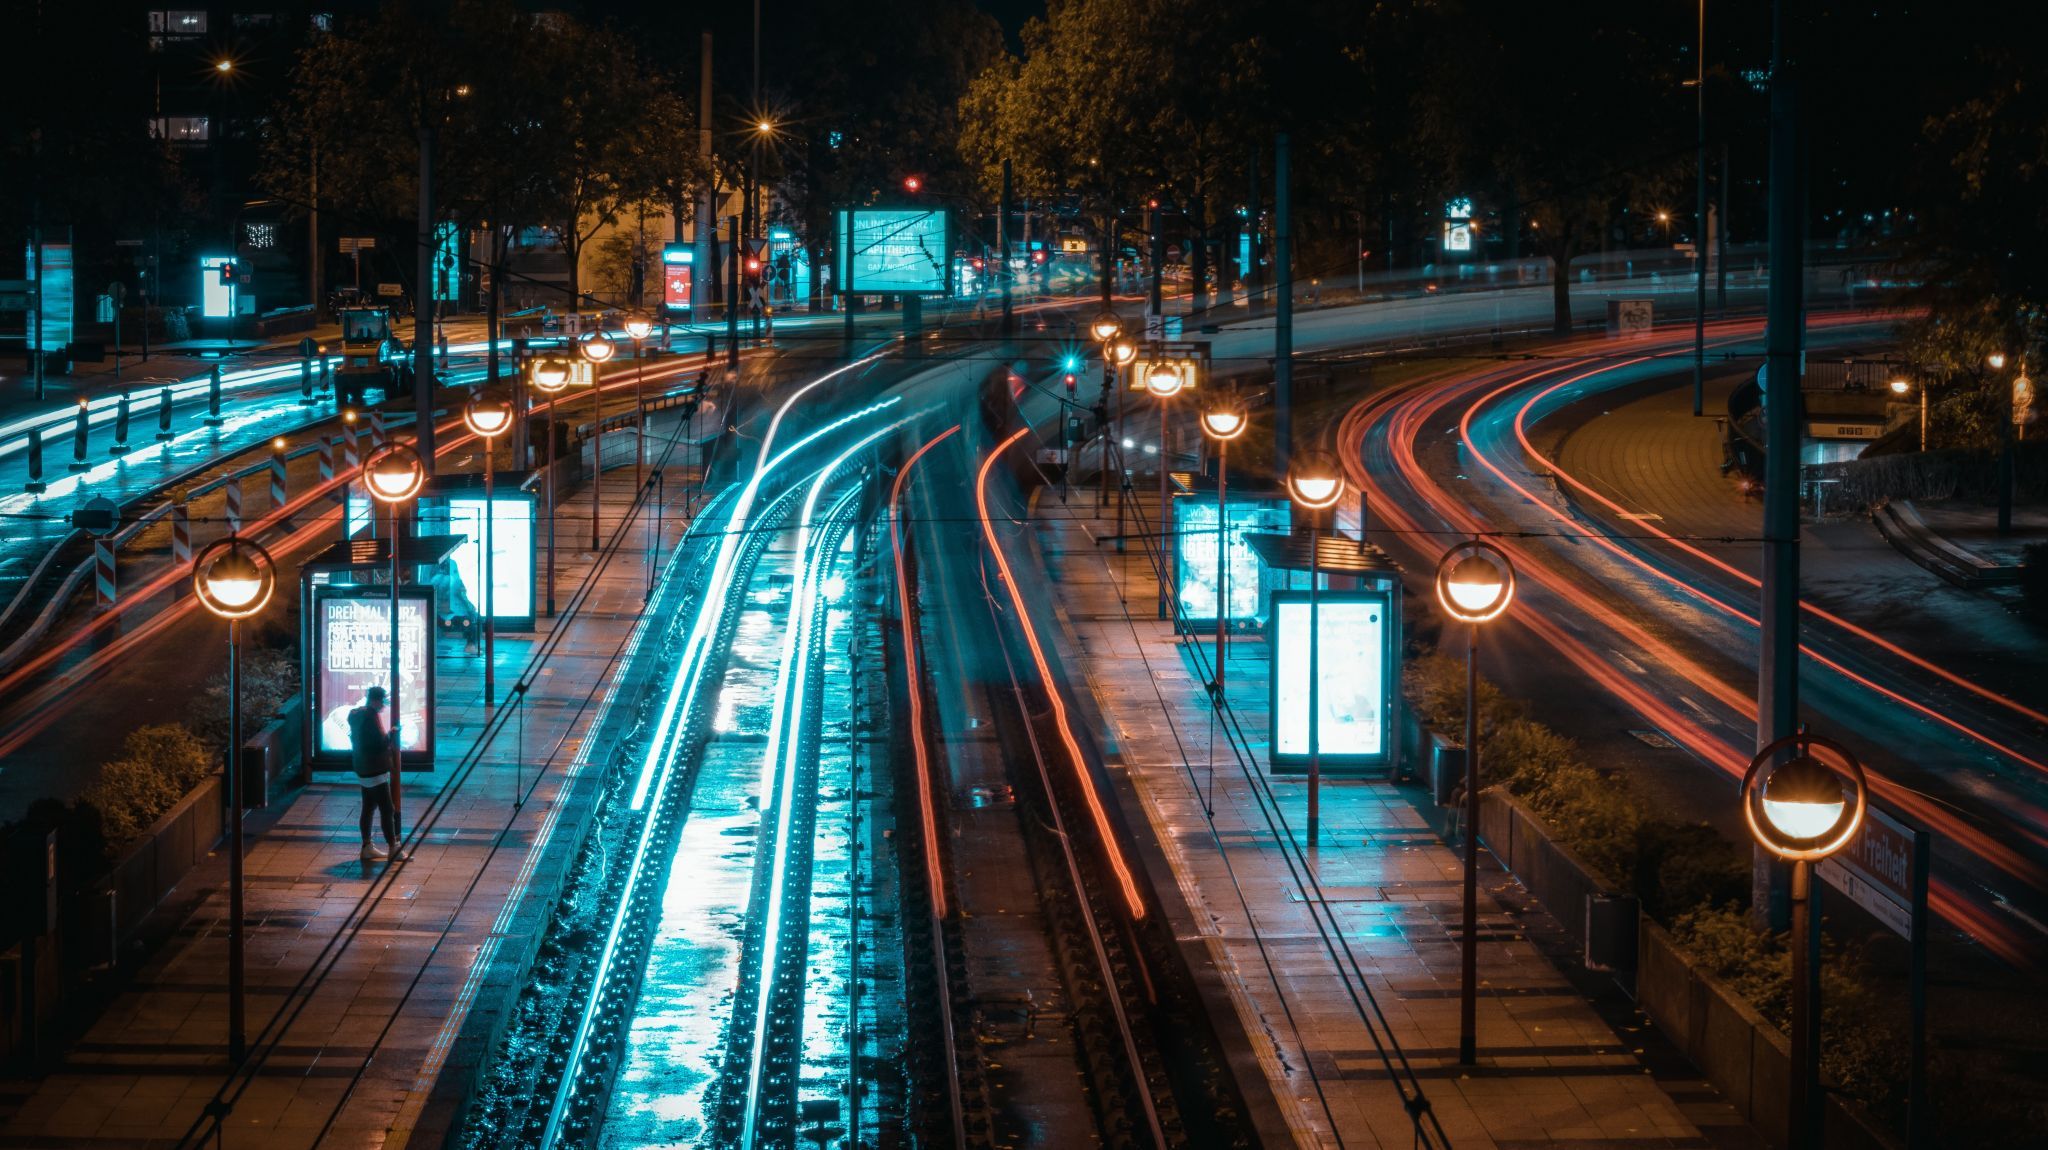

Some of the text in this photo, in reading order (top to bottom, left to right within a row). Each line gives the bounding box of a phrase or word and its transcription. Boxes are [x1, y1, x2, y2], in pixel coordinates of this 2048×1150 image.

[867, 245, 917, 255] APOTHEKE
[569, 320, 575, 332] 1
[1150, 322, 1158, 335] 2
[329, 606, 355, 620] DREH
[361, 606, 384, 620] MAL
[1864, 824, 1908, 889] Freiheit
